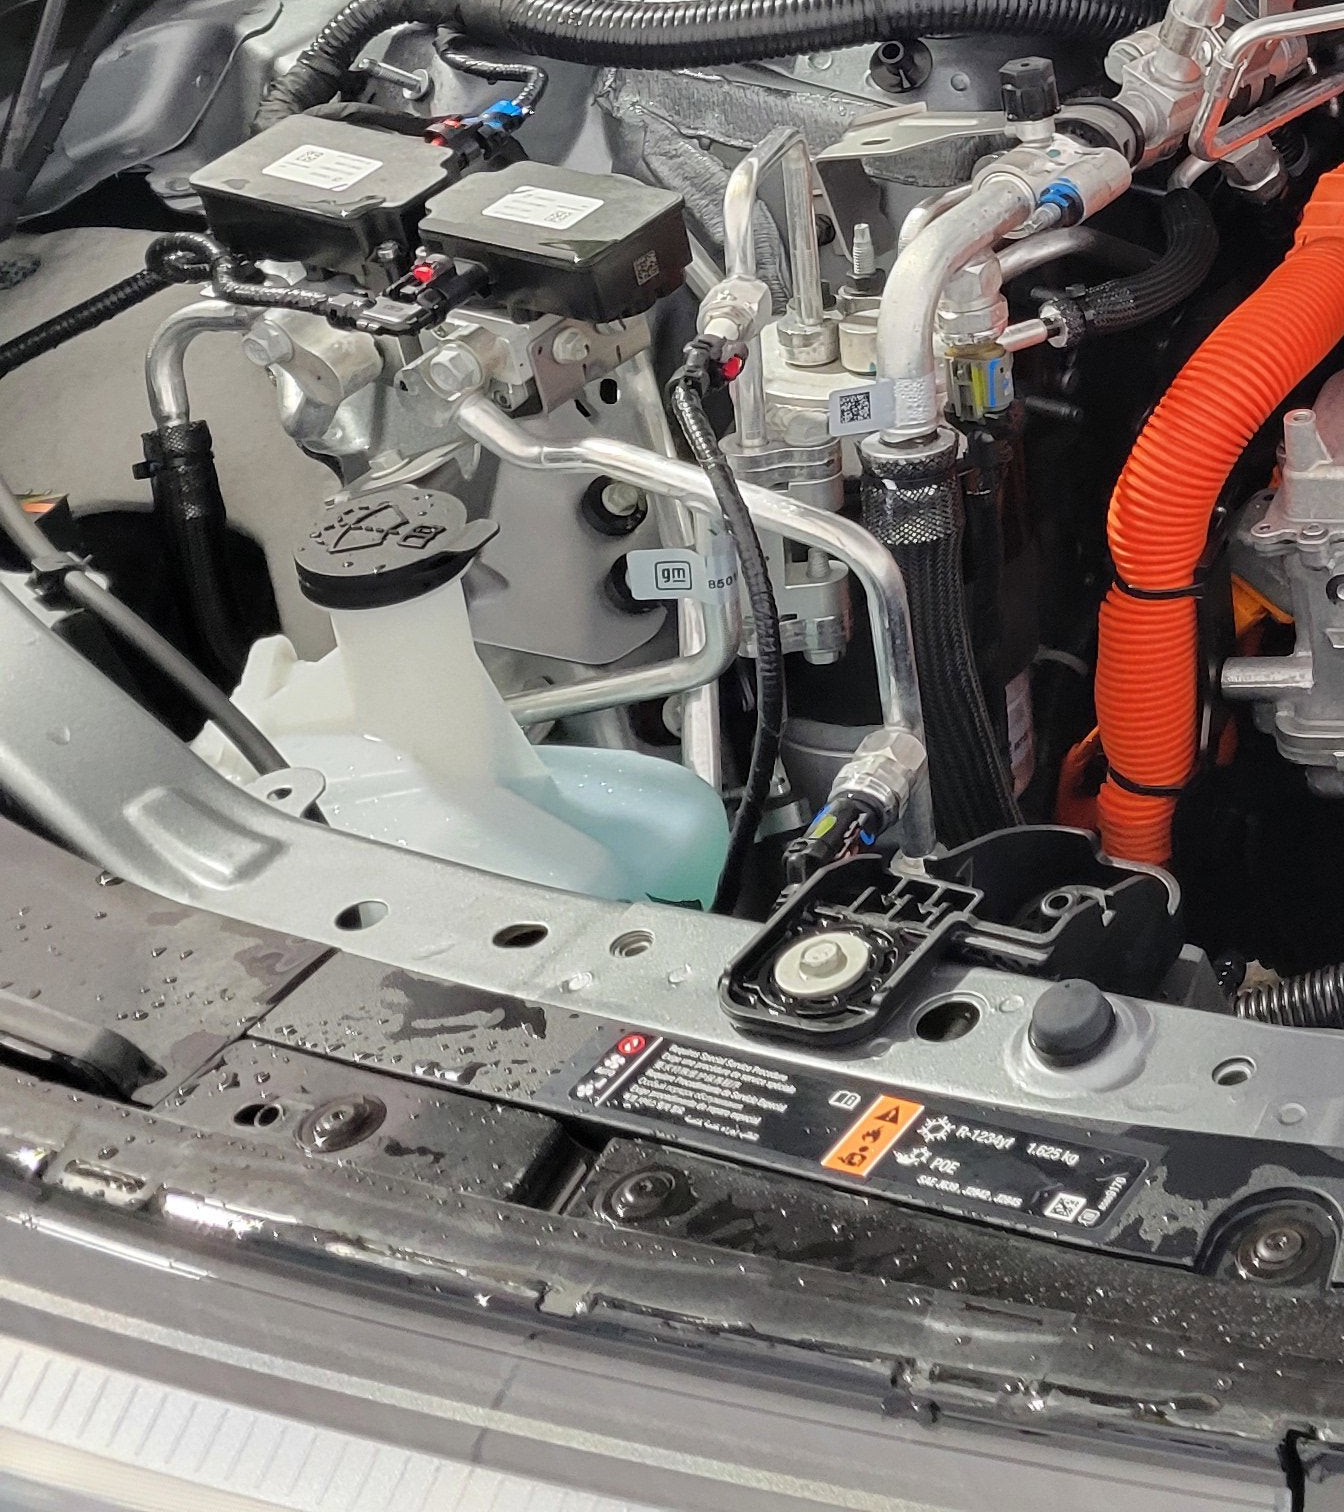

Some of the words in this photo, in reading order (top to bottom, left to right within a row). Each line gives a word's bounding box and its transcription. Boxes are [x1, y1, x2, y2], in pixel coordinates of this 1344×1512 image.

[661, 567, 687, 584] gm
[955, 1125, 1016, 1150] R-1234yf
[1026, 1142, 1062, 1161] 1.625
[1061, 1151, 1080, 1167] kg
[930, 1159, 961, 1176] POE
[916, 1174, 937, 1188] SAE
